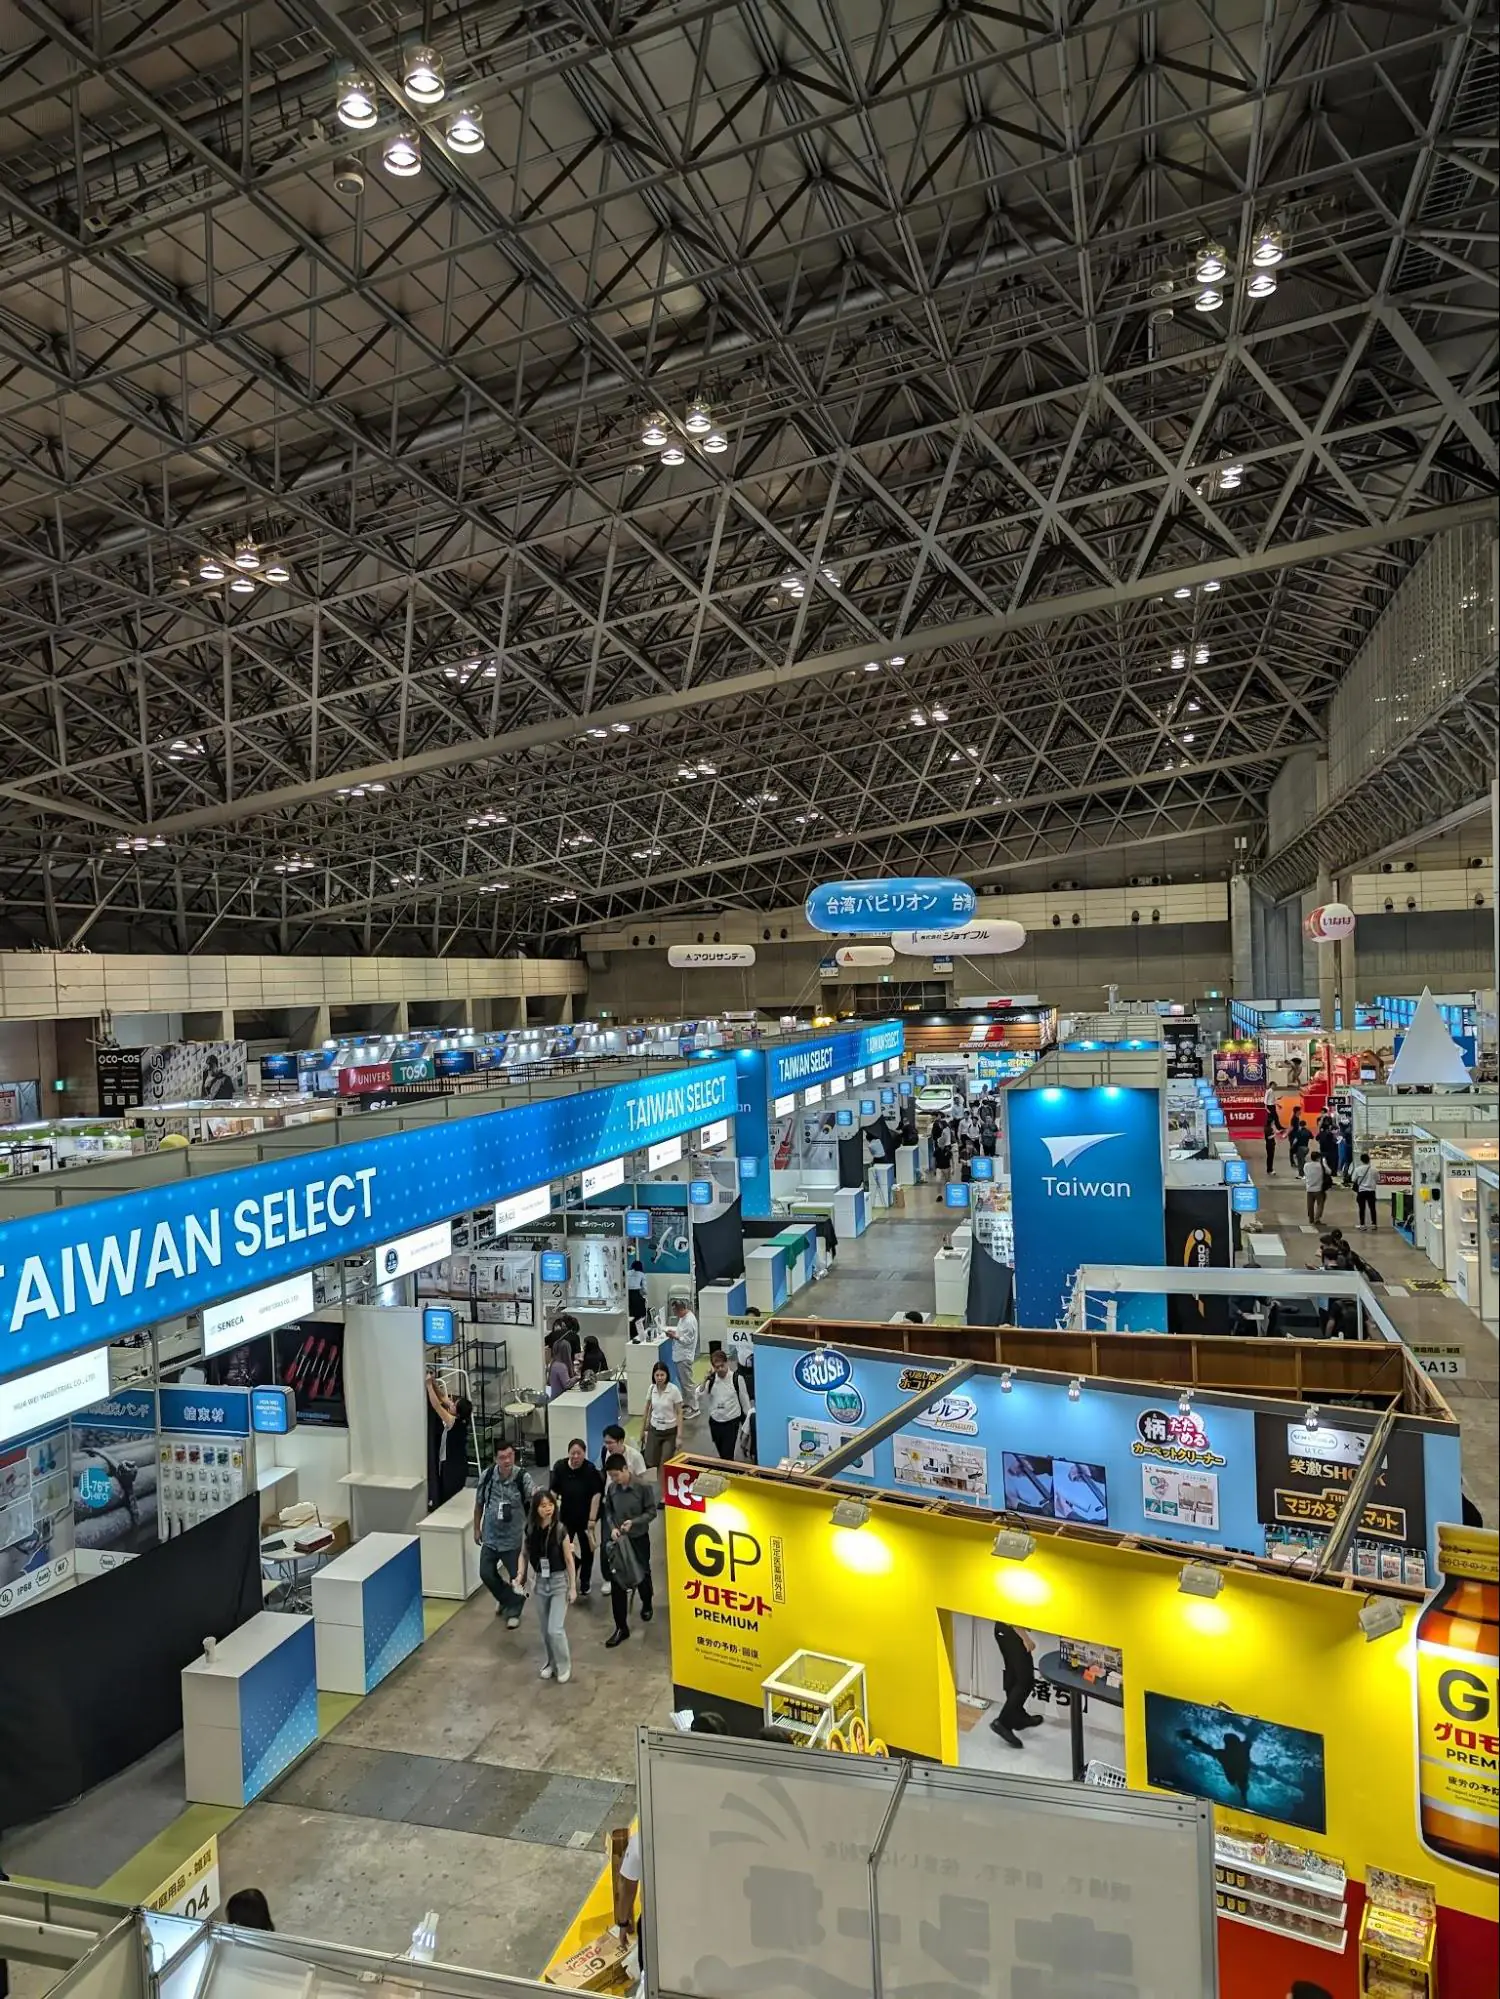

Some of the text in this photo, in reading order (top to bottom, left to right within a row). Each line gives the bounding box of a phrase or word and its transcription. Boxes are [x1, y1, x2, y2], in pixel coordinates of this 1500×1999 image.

[826, 894, 938, 915] 台湾パビリオン
[693, 953, 747, 961] アクリサンデー
[866, 1030, 900, 1054] TAIWAN SELECT
[400, 1063, 428, 1081] TOSO
[779, 1046, 833, 1082] TAIWAN SELECT
[358, 1071, 391, 1085] UNIVERS
[626, 1076, 727, 1132] TAIWAN SELECT
[1041, 1176, 1131, 1198] Taiwan
[233, 1166, 378, 1257] SELECT
[217, 1315, 245, 1332] SENECA
[802, 1357, 845, 1386] BRUSH
[1133, 1442, 1224, 1464] カーペットクリーナー
[684, 1523, 762, 1583] GP
[684, 1580, 773, 1616] グロモント
[694, 1607, 759, 1632] PREMIUM
